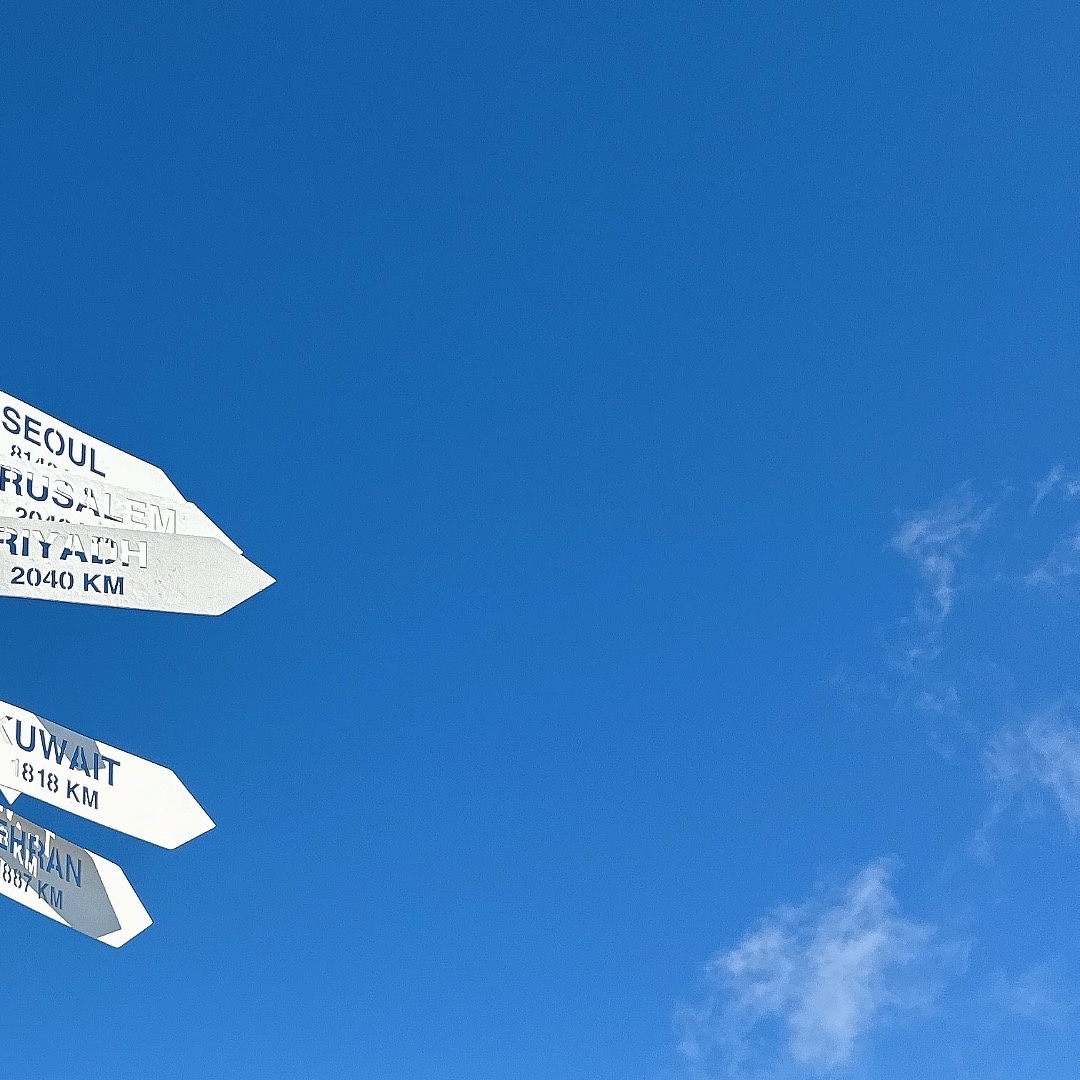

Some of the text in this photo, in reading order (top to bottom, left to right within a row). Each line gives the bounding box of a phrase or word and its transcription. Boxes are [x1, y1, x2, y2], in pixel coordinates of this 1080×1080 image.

[1, 405, 106, 478] SEOUL
[10, 566, 125, 596] 2040 KM
[10, 757, 99, 811] 1818 KM
[38, 879, 64, 910] KM
